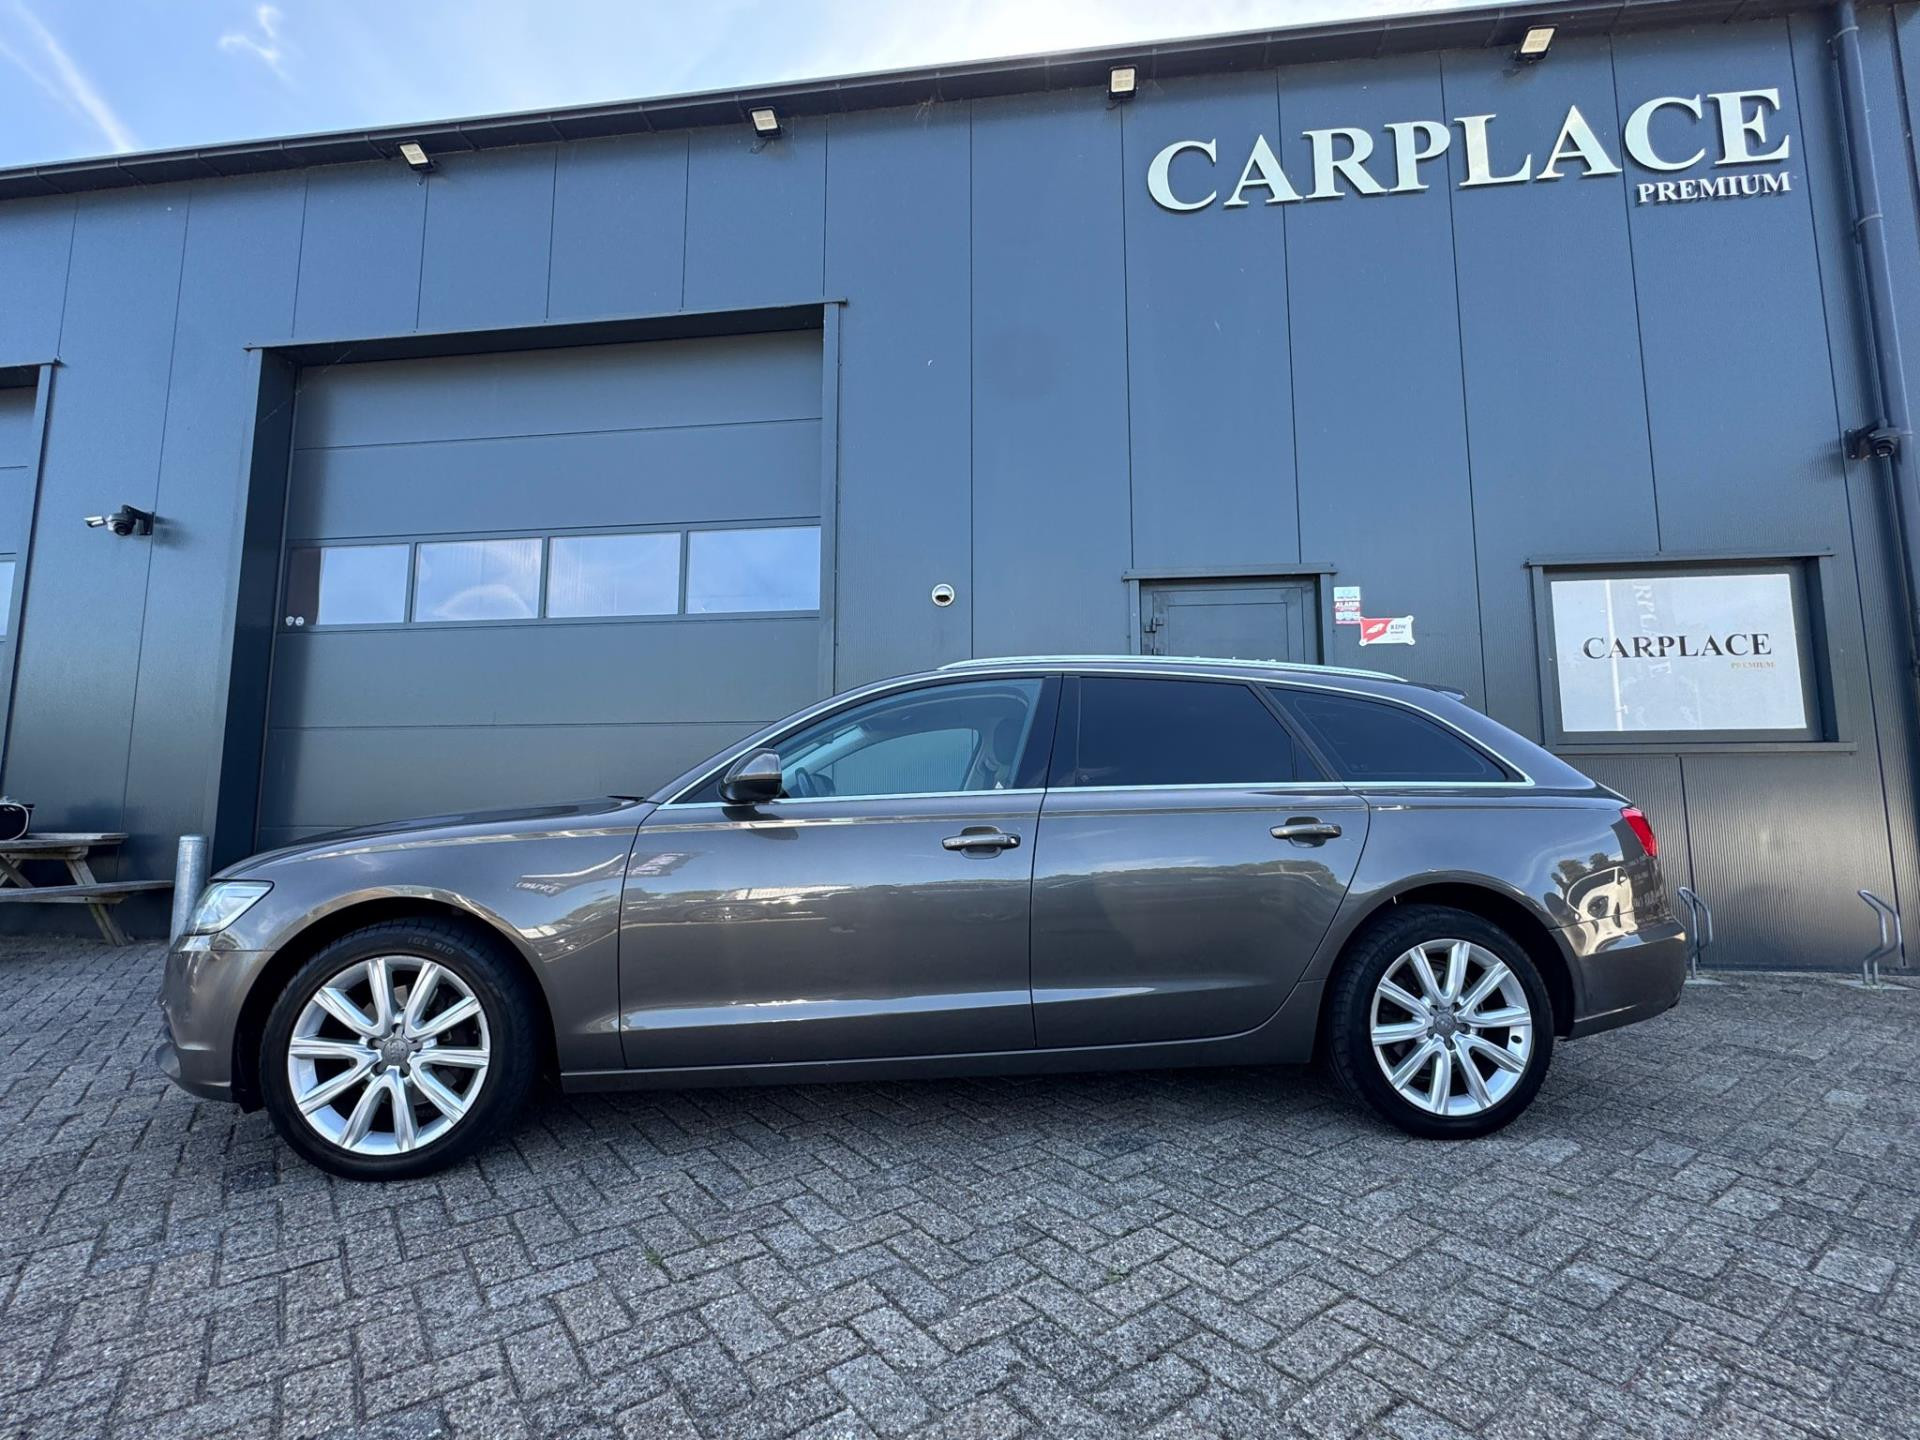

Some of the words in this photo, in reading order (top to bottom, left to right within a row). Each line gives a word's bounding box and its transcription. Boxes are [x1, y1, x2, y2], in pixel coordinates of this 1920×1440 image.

[1147, 88, 1790, 211] CARPLACE
[1637, 171, 1792, 203] PREMIUM
[1583, 633, 1772, 659] CARPLACE
